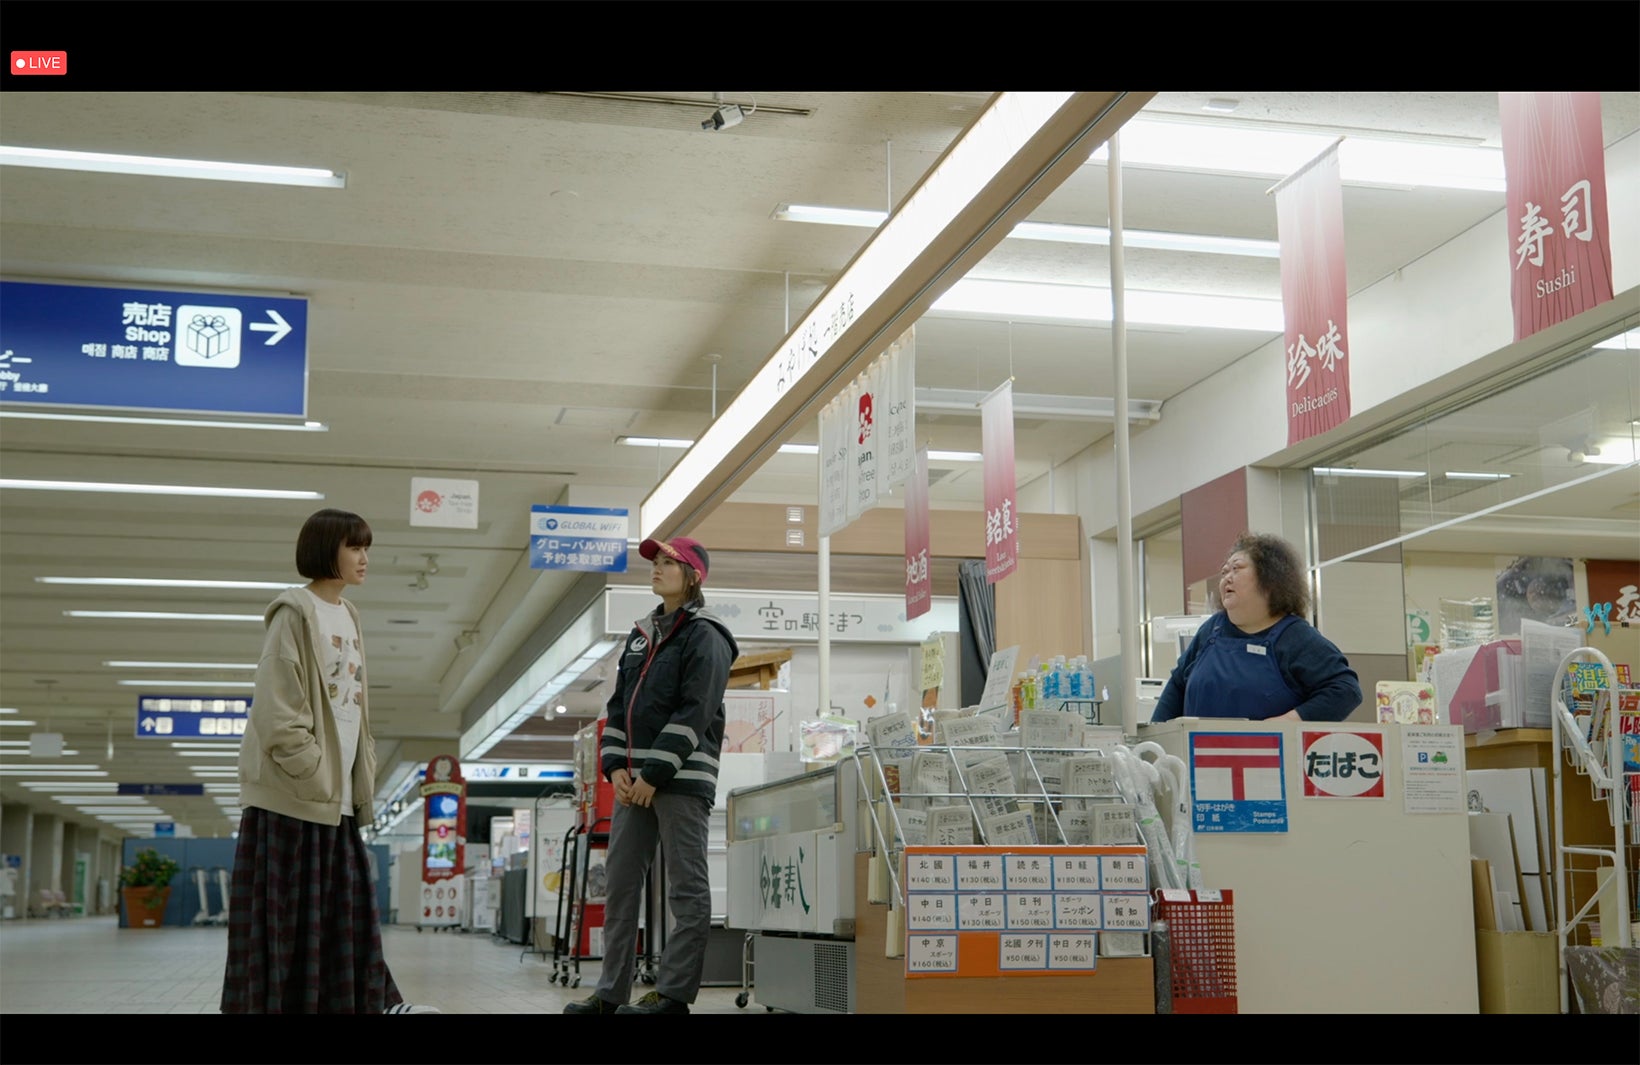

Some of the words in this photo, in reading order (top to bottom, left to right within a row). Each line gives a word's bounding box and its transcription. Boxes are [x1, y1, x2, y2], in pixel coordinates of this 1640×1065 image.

[1516, 179, 1592, 271] 寿司
[1536, 265, 1576, 299] Sushi
[122, 302, 172, 327] 売店
[125, 326, 171, 345] Shop
[1287, 319, 1344, 390] 珍味
[1291, 387, 1338, 418] Delicacies
[560, 520, 597, 530] GLOBAL
[986, 499, 1013, 546] 銘菓
[1306, 751, 1381, 779] たばこ
[968, 860, 991, 870] 福井
[1065, 861, 1087, 870] 日経
[1112, 861, 1134, 870] 朝日
[921, 899, 943, 908] 中日
[970, 897, 992, 906] 中日
[1019, 897, 1042, 906] 日刊
[1062, 905, 1094, 915] ニッポン
[1115, 907, 1137, 916] 報知
[921, 938, 945, 948] 中京
[1053, 939, 1069, 948] 中日
